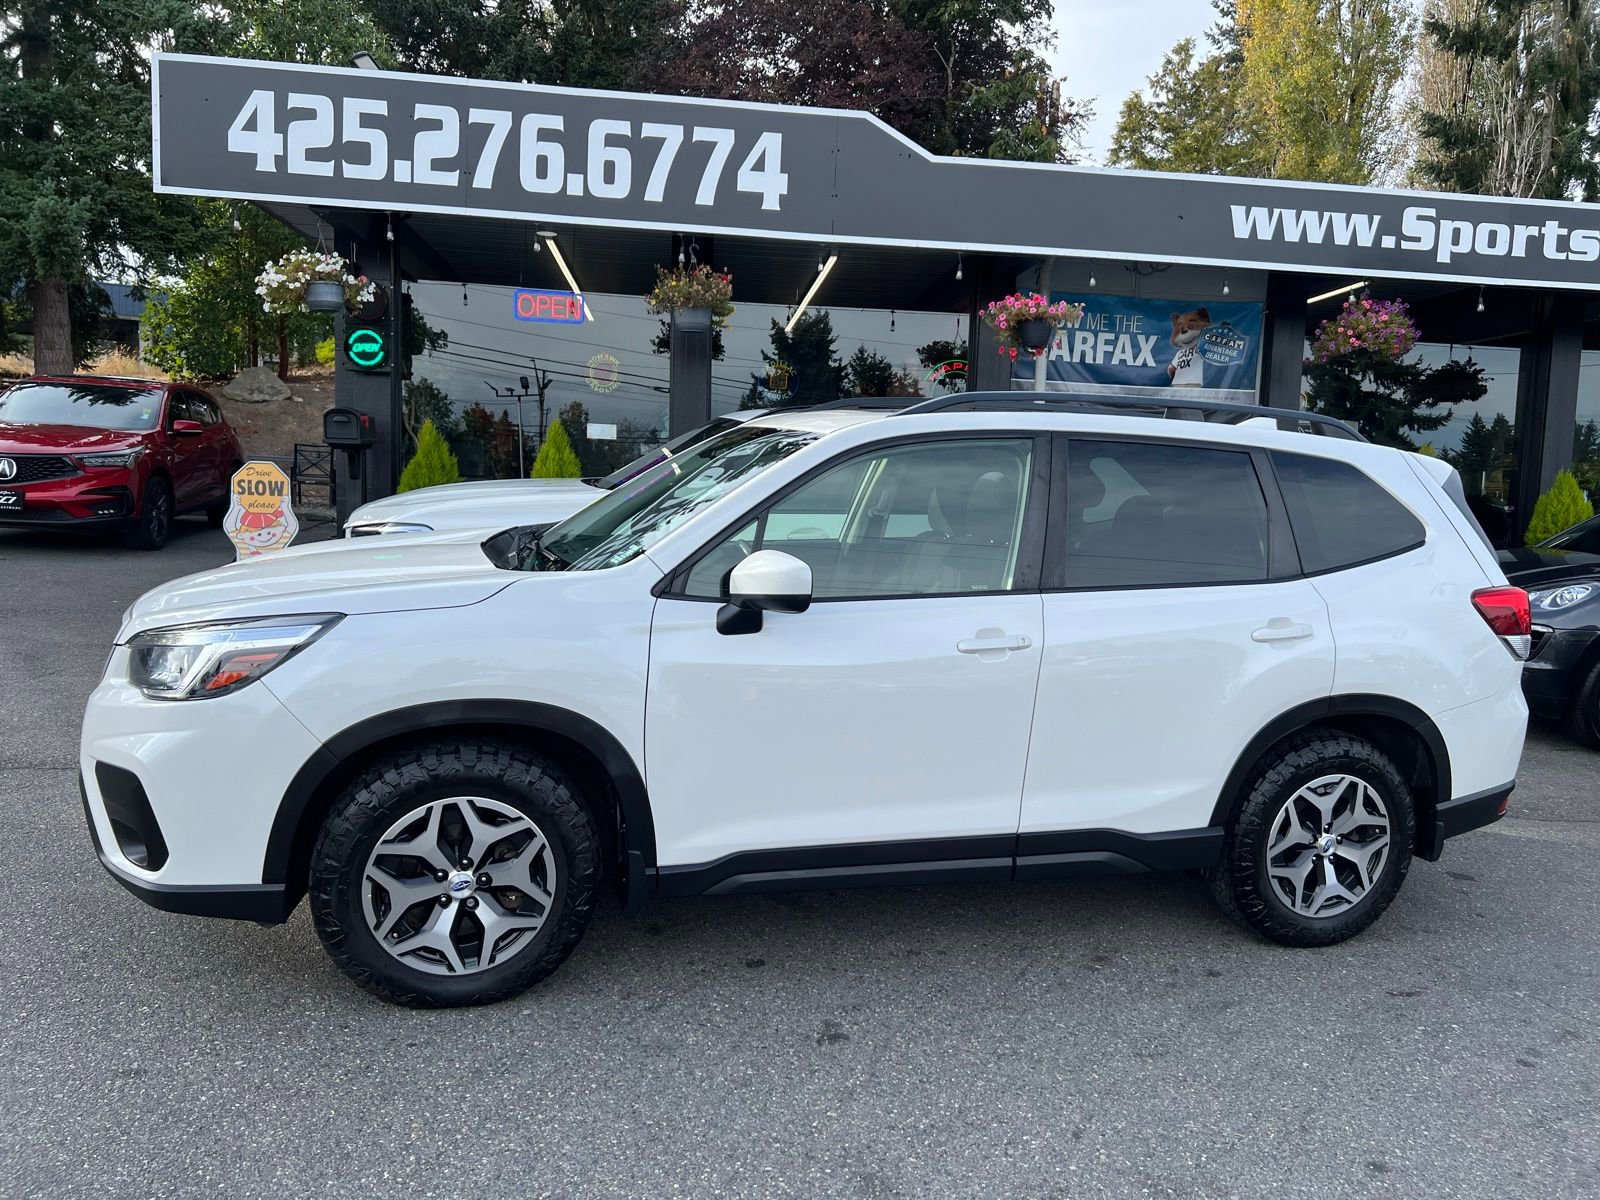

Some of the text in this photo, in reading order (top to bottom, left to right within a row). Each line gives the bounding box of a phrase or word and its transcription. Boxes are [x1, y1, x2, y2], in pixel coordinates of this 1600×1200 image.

[226, 89, 789, 211] 425.276.6774
[1230, 204, 1600, 264] www.Sports
[517, 293, 582, 320] OPEN
[1086, 312, 1110, 331] ME
[1113, 314, 1144, 333] THE
[352, 343, 381, 353] OPEN
[1048, 330, 1158, 367] ARFAX
[1204, 333, 1244, 350] CARFAX
[1178, 349, 1194, 360] CAR
[1204, 343, 1239, 357] ADVANTAGE
[1205, 352, 1230, 363] DEALER
[1177, 358, 1192, 369] FOX
[246, 466, 272, 476] Drive
[237, 479, 284, 496] SLOW
[248, 499, 276, 509] please
